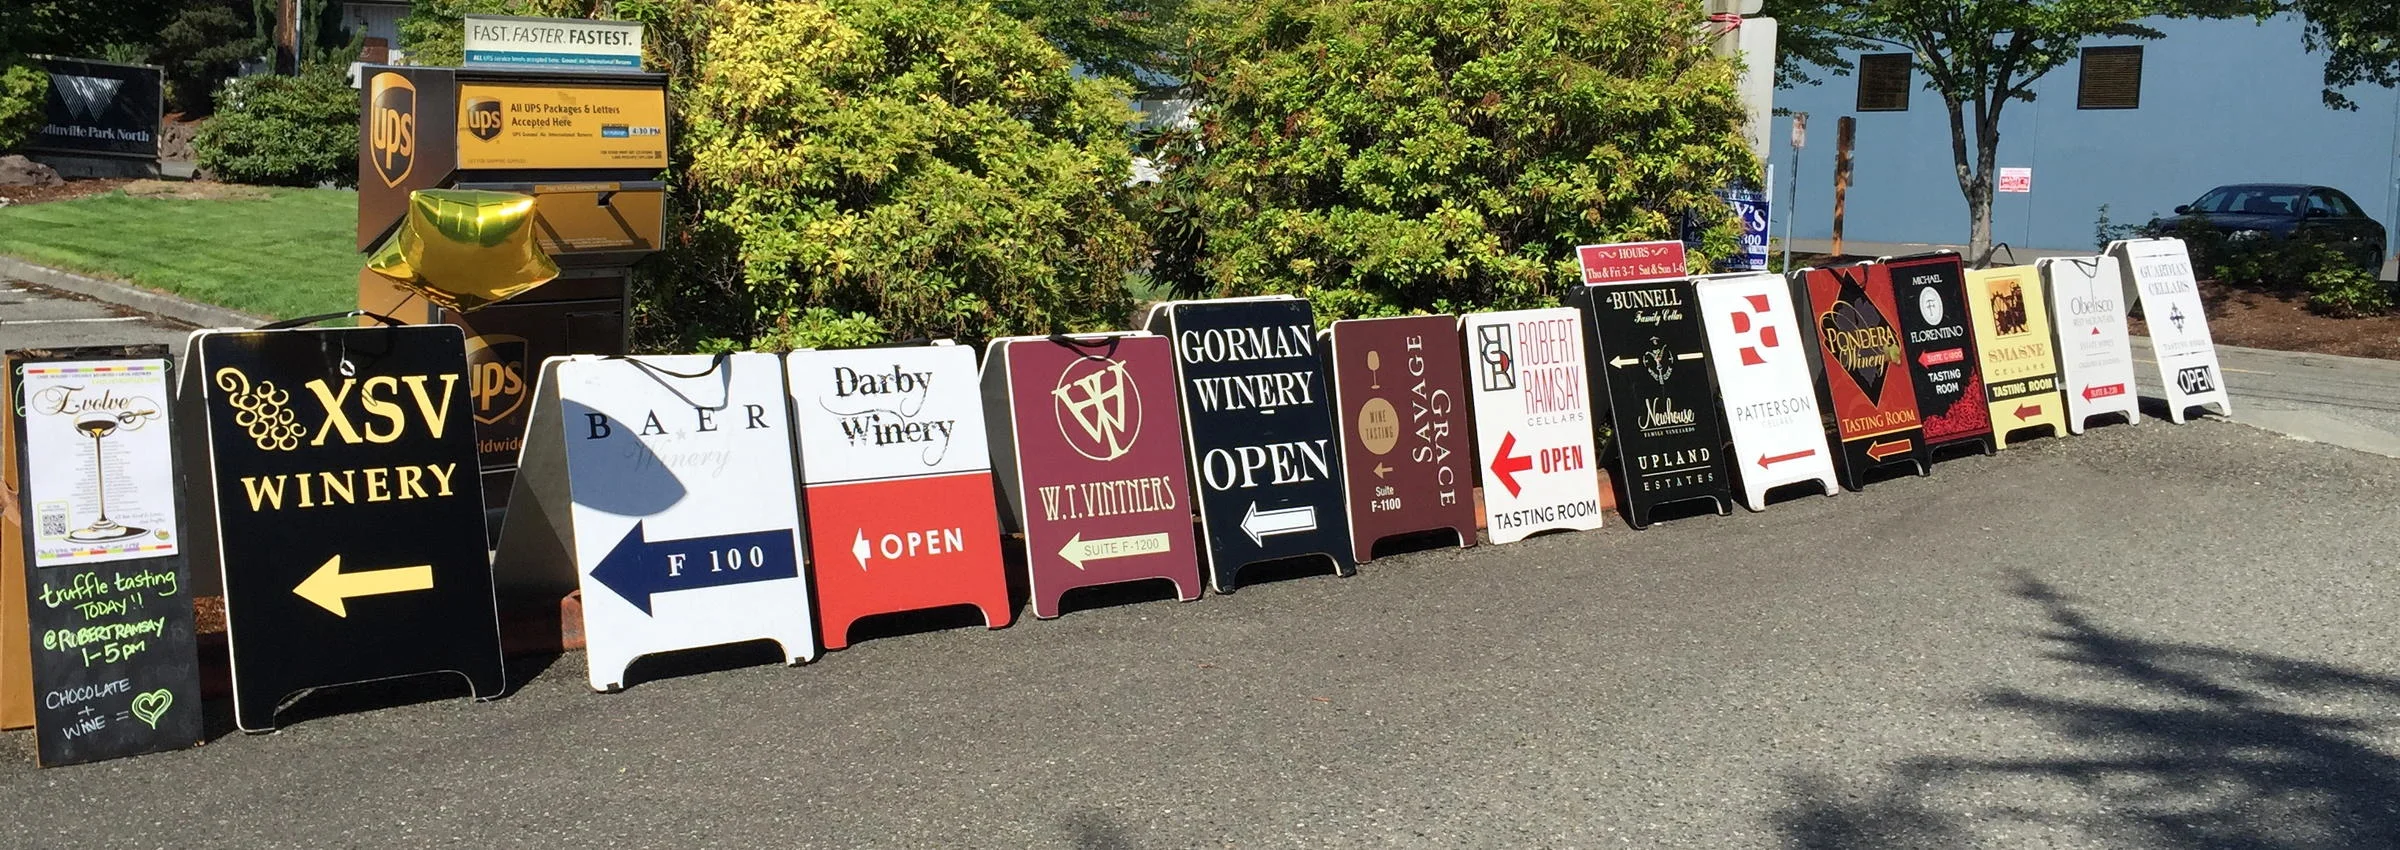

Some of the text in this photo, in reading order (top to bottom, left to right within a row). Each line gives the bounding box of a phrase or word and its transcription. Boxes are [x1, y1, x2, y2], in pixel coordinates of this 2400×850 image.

[474, 25, 633, 46] FAST. FASTER. FASTEST.
[511, 103, 620, 116] All UPS Packages & Letters
[88, 126, 115, 139] Park
[116, 128, 150, 143] North
[468, 110, 502, 138] ups
[511, 117, 573, 129] Accepted Here
[374, 106, 412, 170] ups
[1618, 247, 1650, 260] HOURS
[1621, 265, 1635, 277] 3-7
[1672, 262, 1685, 274] 1-6
[1912, 273, 1943, 286] MICHAEL
[2140, 263, 2189, 279] GUARDIAN
[1611, 288, 1683, 310] BUNNELL
[2148, 280, 2191, 296] CELLARS
[2071, 295, 2114, 316] Obelisco
[1180, 324, 1313, 364] GORMAN
[1517, 318, 1576, 367] ROBERT
[1827, 325, 1897, 354] PONDERA
[1910, 325, 1964, 344] FLORENTINO
[1839, 347, 1886, 377] Winery
[1988, 342, 2046, 364] SMASNE
[1927, 367, 1962, 383] TASTING
[1994, 363, 2046, 377] CELLARS
[2179, 368, 2214, 393] OPEN
[833, 364, 933, 418] Darby
[1193, 371, 1316, 413] WINERY
[1406, 334, 1434, 464] SAVAGE
[1522, 365, 1582, 415] RAMSAY
[1935, 382, 1960, 395] ROOM
[1992, 378, 2054, 398] TASTING ROOM
[305, 373, 459, 447] XSV
[1370, 408, 1388, 424] WINE
[1527, 413, 1585, 427] CELLARS
[1637, 397, 1696, 430] Newhouse
[1736, 396, 1811, 422] PATTERSON
[1842, 408, 1916, 434] TASTING ROOM
[584, 403, 770, 441] BAER
[1364, 425, 1394, 442] TASTING
[839, 412, 956, 467] Winery
[1430, 388, 1457, 507] GRACE
[624, 438, 731, 479] Winery
[1203, 439, 1330, 492] OPEN
[1540, 444, 1584, 475] OPEN
[1638, 447, 1710, 471] UPLAND
[240, 462, 457, 512] WINERY
[1375, 485, 1395, 497] Suite
[1643, 472, 1714, 492] ESTATES
[1370, 496, 1402, 513] F-1100
[1494, 499, 1598, 530] TASTING ROOM
[880, 527, 964, 560] OPEN
[1083, 537, 1160, 557] SUITE F-1200
[667, 545, 764, 577] F 100
[38, 569, 178, 608] truffle tasting
[45, 678, 132, 710] CHOCOLATE
